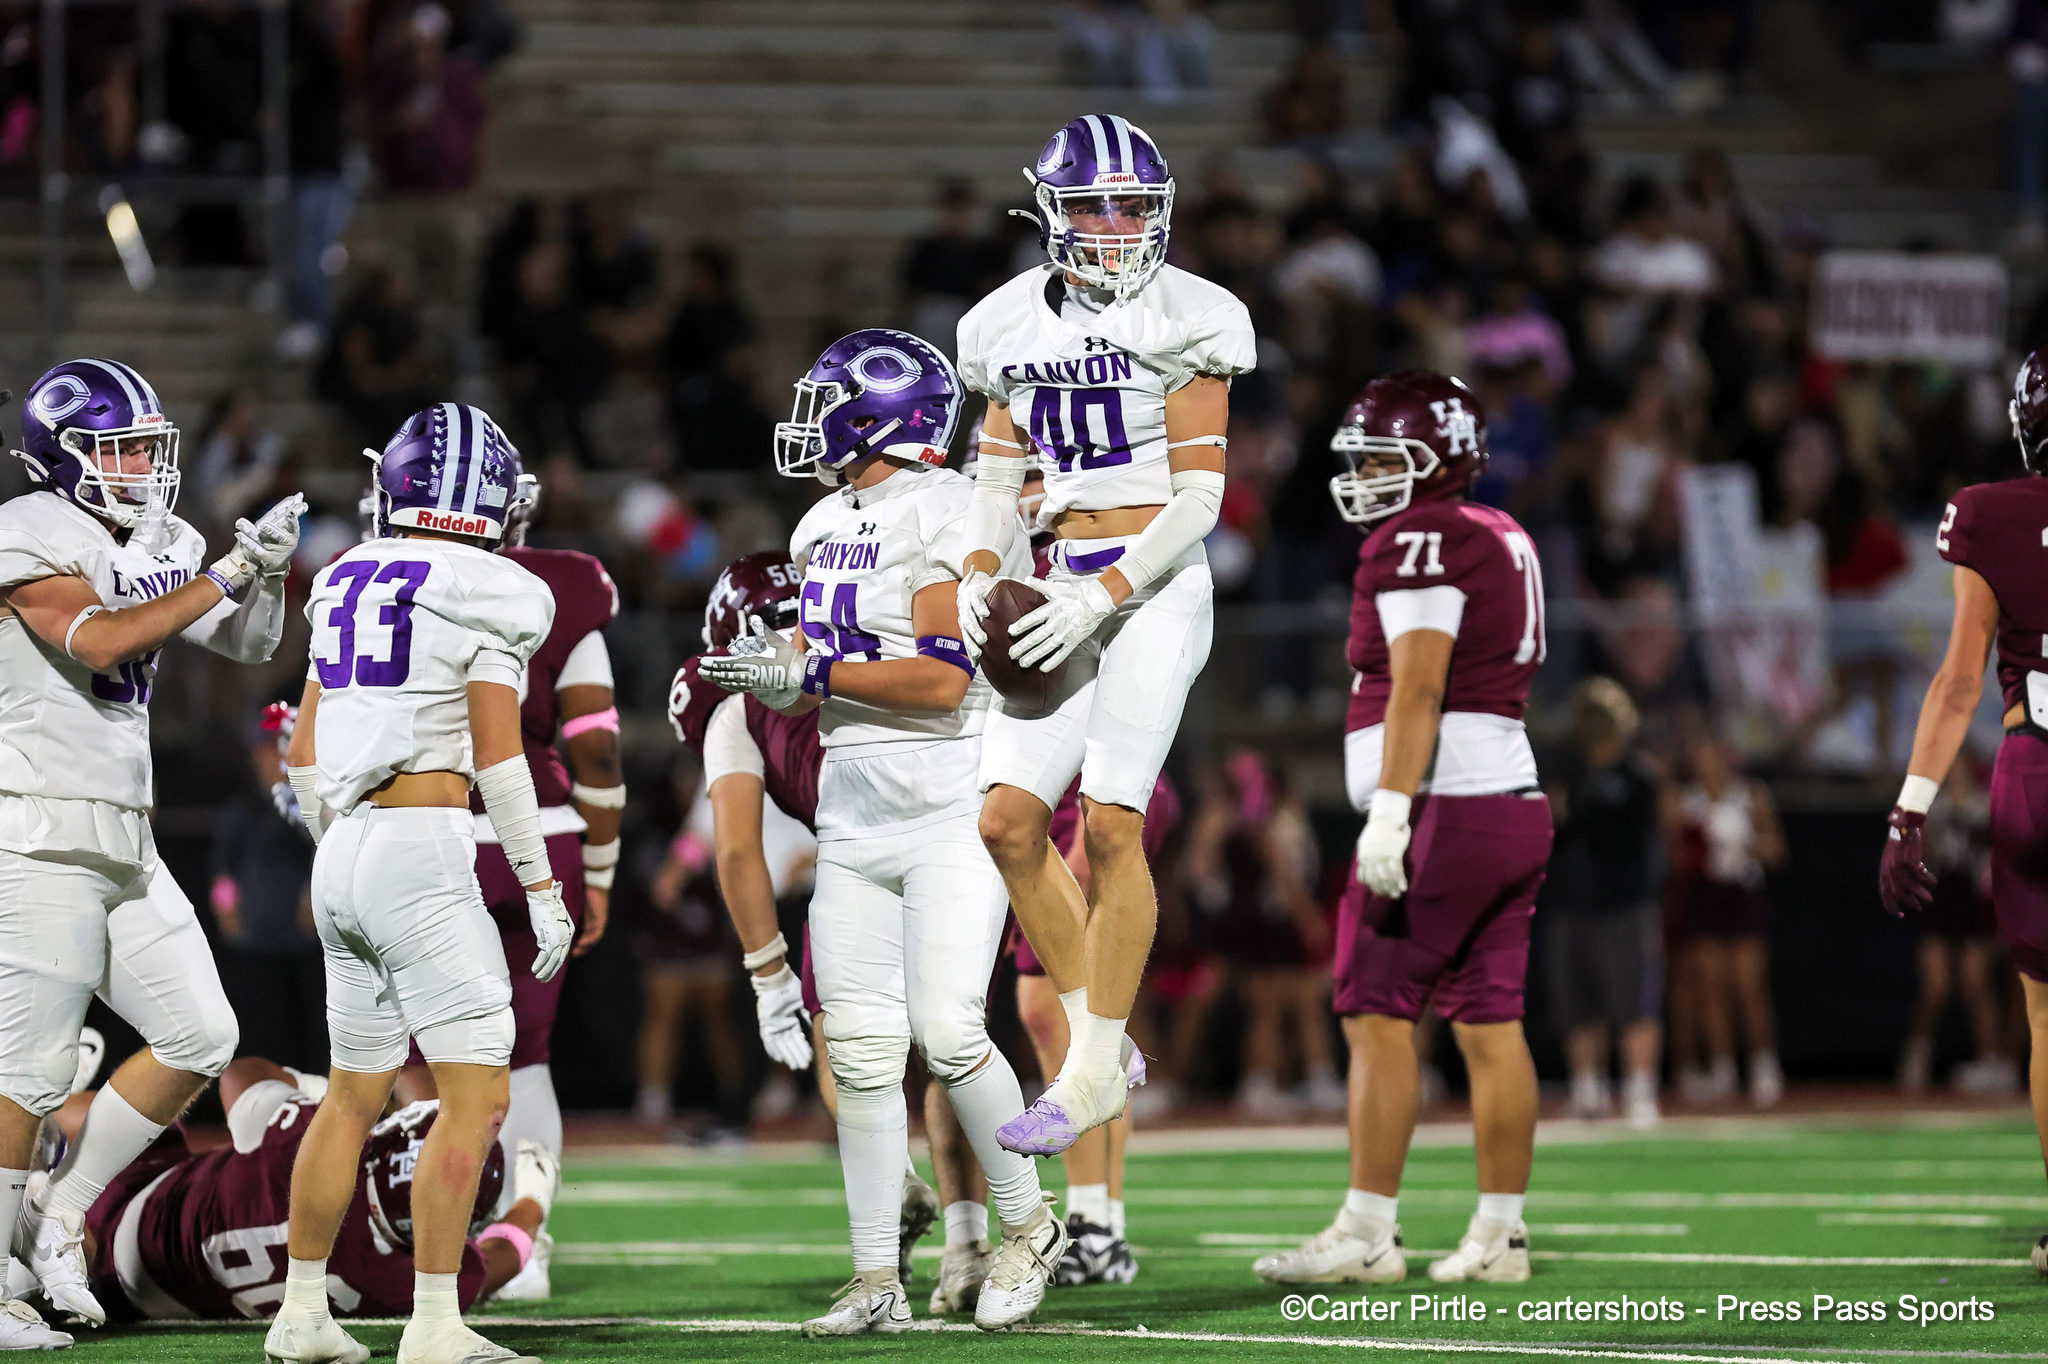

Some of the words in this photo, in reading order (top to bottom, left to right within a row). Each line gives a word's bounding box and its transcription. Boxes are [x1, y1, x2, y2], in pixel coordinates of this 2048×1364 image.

[1098, 174, 1135, 183] Riddell
[1001, 351, 1132, 385] CANYON
[1030, 386, 1132, 473] 40
[416, 510, 488, 535] Riddell
[808, 542, 880, 570] CANYON
[1395, 532, 1446, 577] 71
[766, 562, 803, 588] 56
[316, 560, 431, 689] 33
[935, 637, 960, 651] NXTRND
